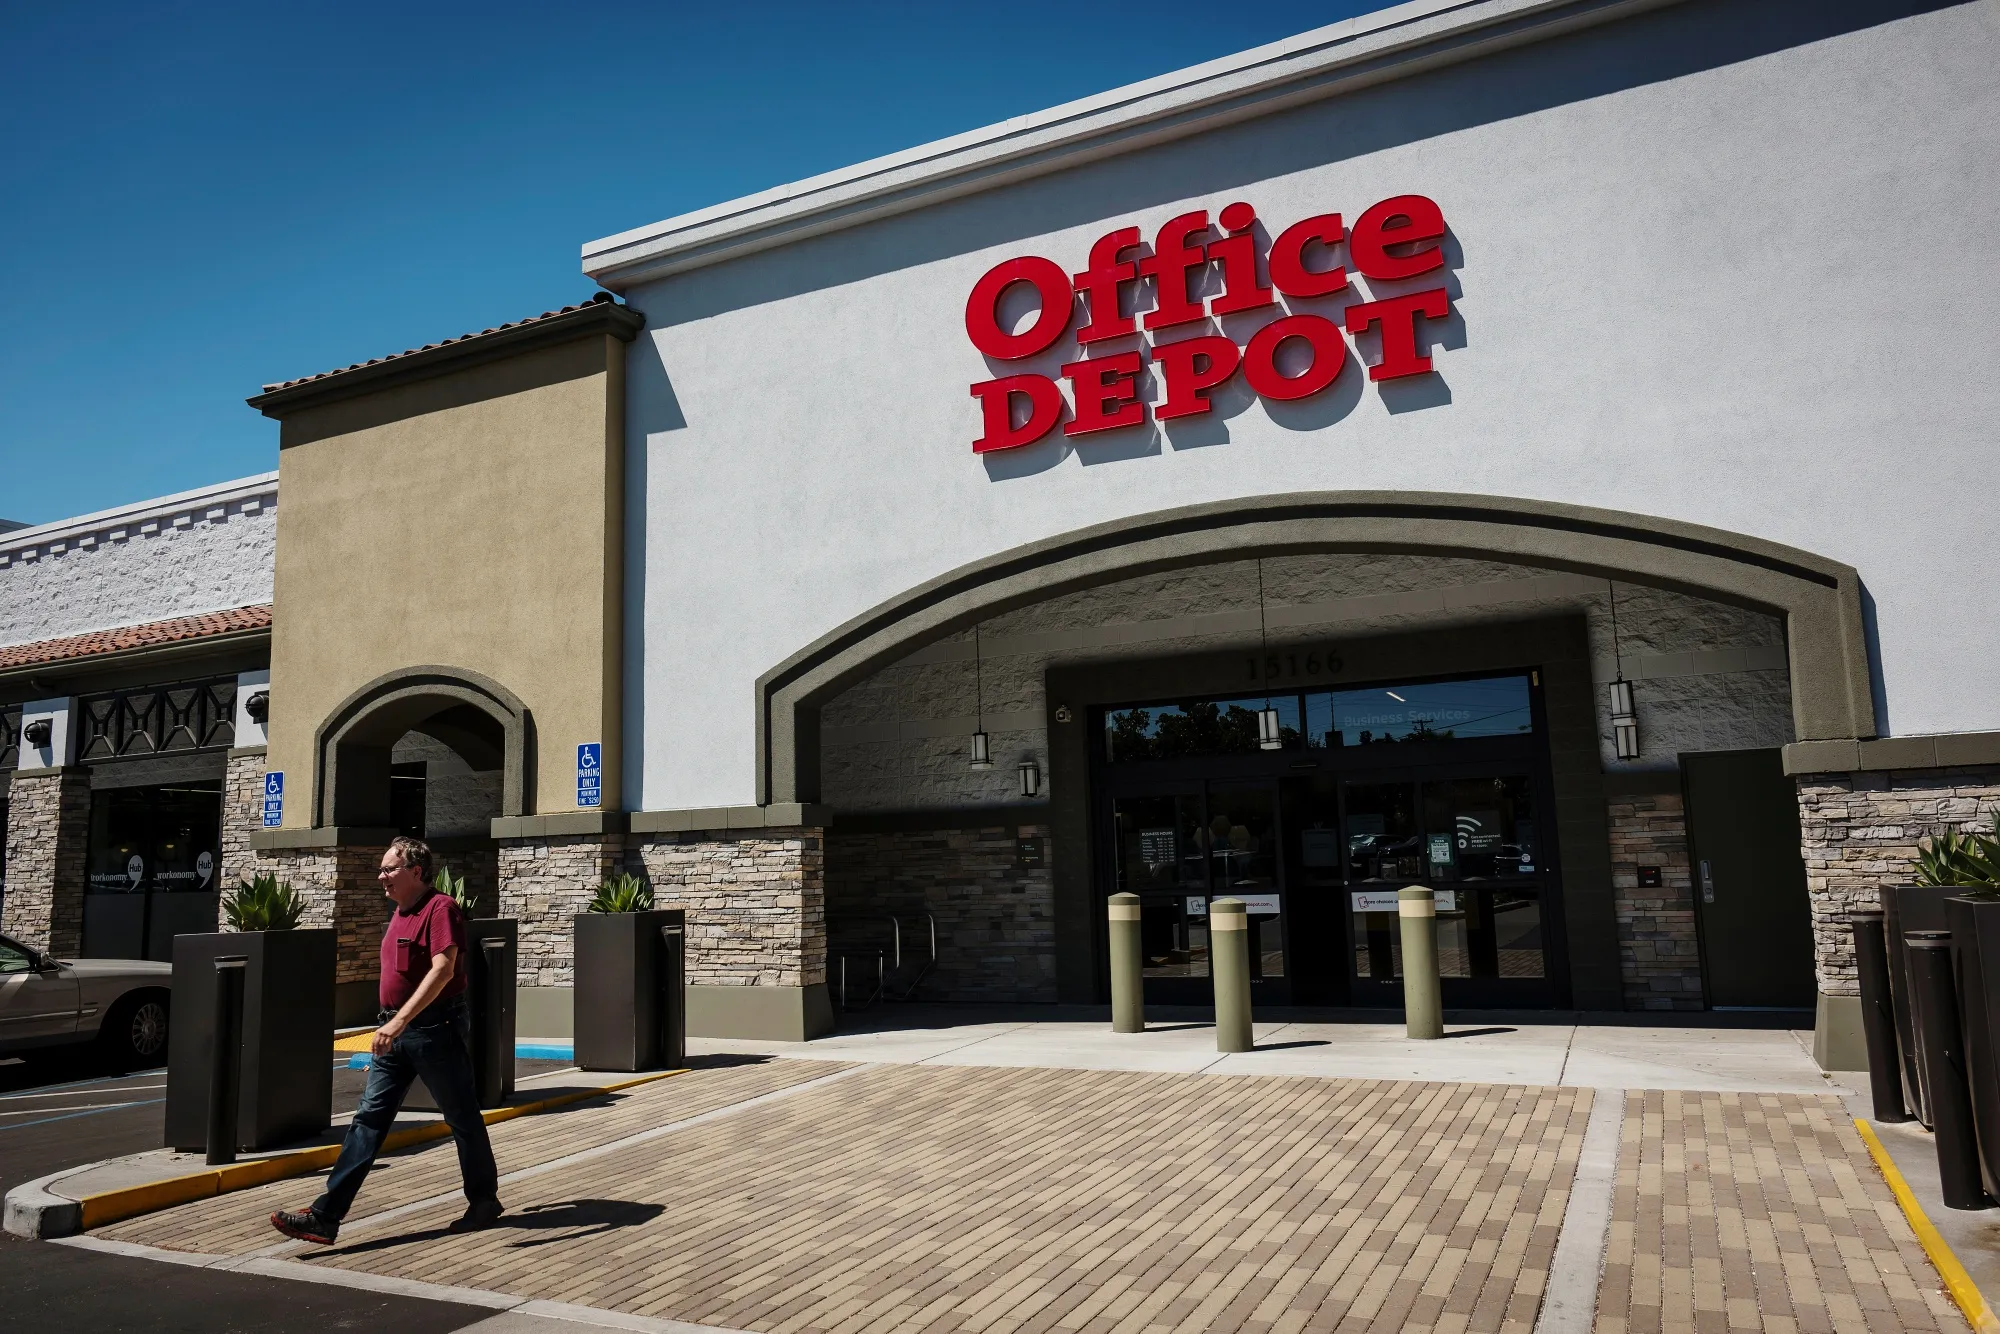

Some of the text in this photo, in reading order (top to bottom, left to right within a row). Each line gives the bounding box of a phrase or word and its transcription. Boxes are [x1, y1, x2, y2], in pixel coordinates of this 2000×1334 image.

[965, 194, 1445, 360] Office
[970, 287, 1449, 455] DEPOT
[1247, 648, 1344, 680] 15166
[1344, 708, 1471, 727] Business Services
[578, 768, 600, 778] PARKING
[582, 778, 596, 788] ONLY
[130, 863, 142, 873] Hub
[198, 860, 212, 869] Hub
